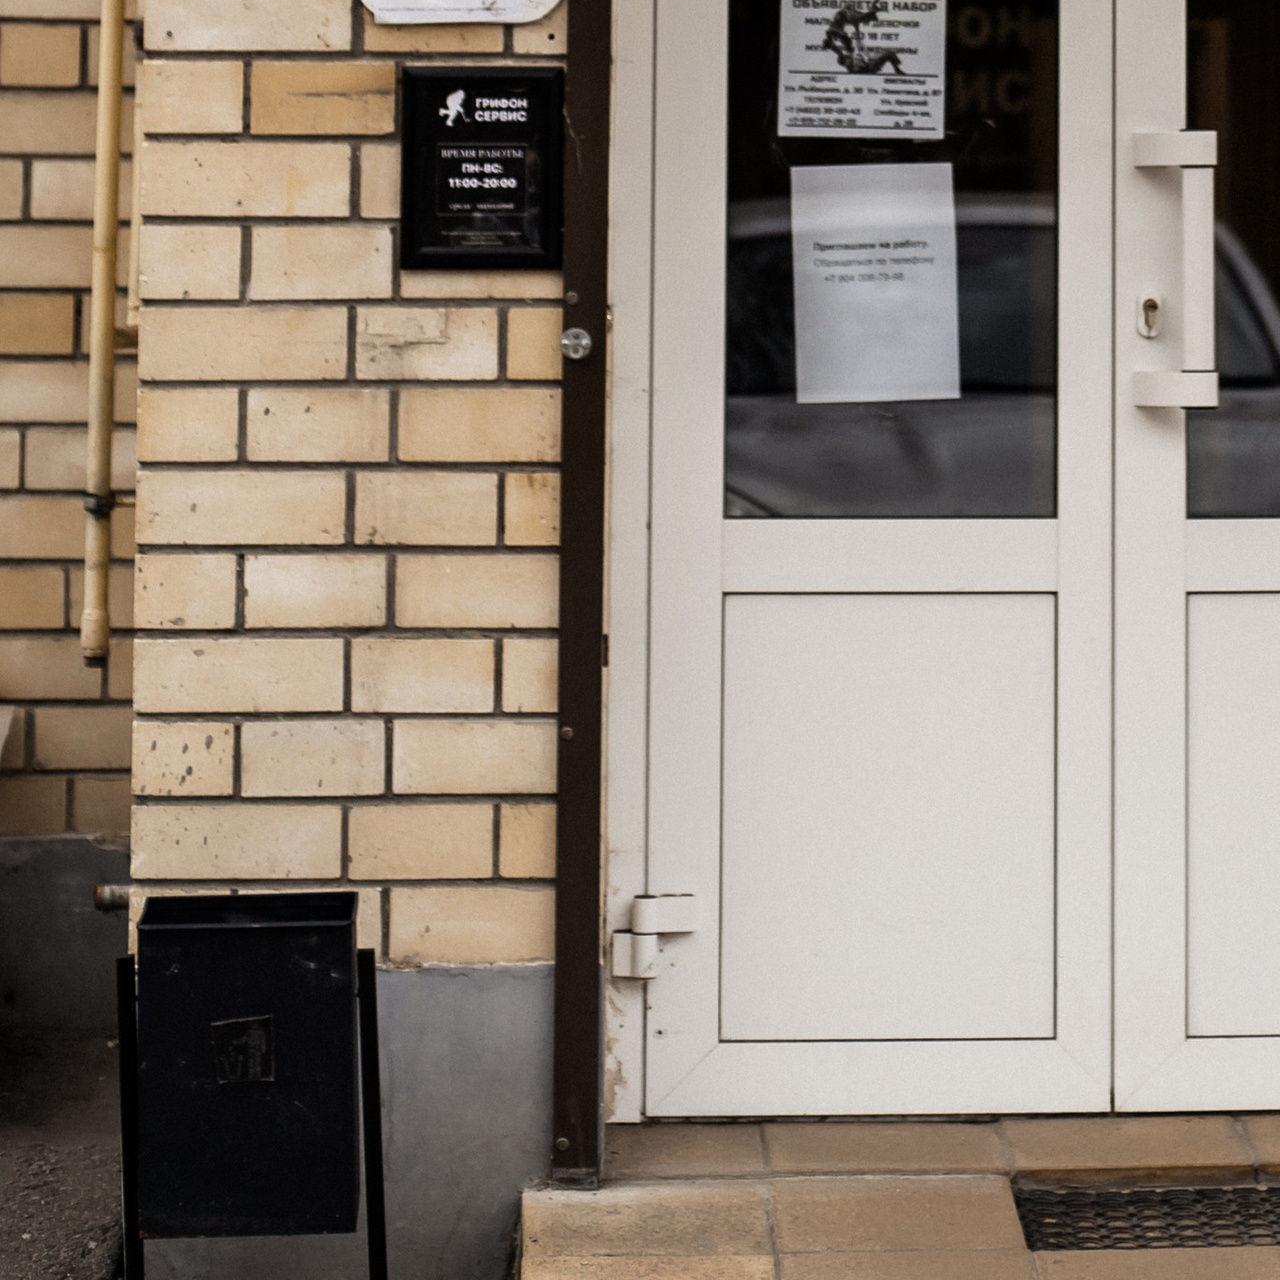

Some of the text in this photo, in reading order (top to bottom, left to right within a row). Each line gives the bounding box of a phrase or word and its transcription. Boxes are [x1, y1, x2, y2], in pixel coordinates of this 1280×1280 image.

[892, 1, 938, 12] НАБОР
[475, 97, 529, 110] ГРИФОН
[474, 110, 528, 122] СЕРВИС
